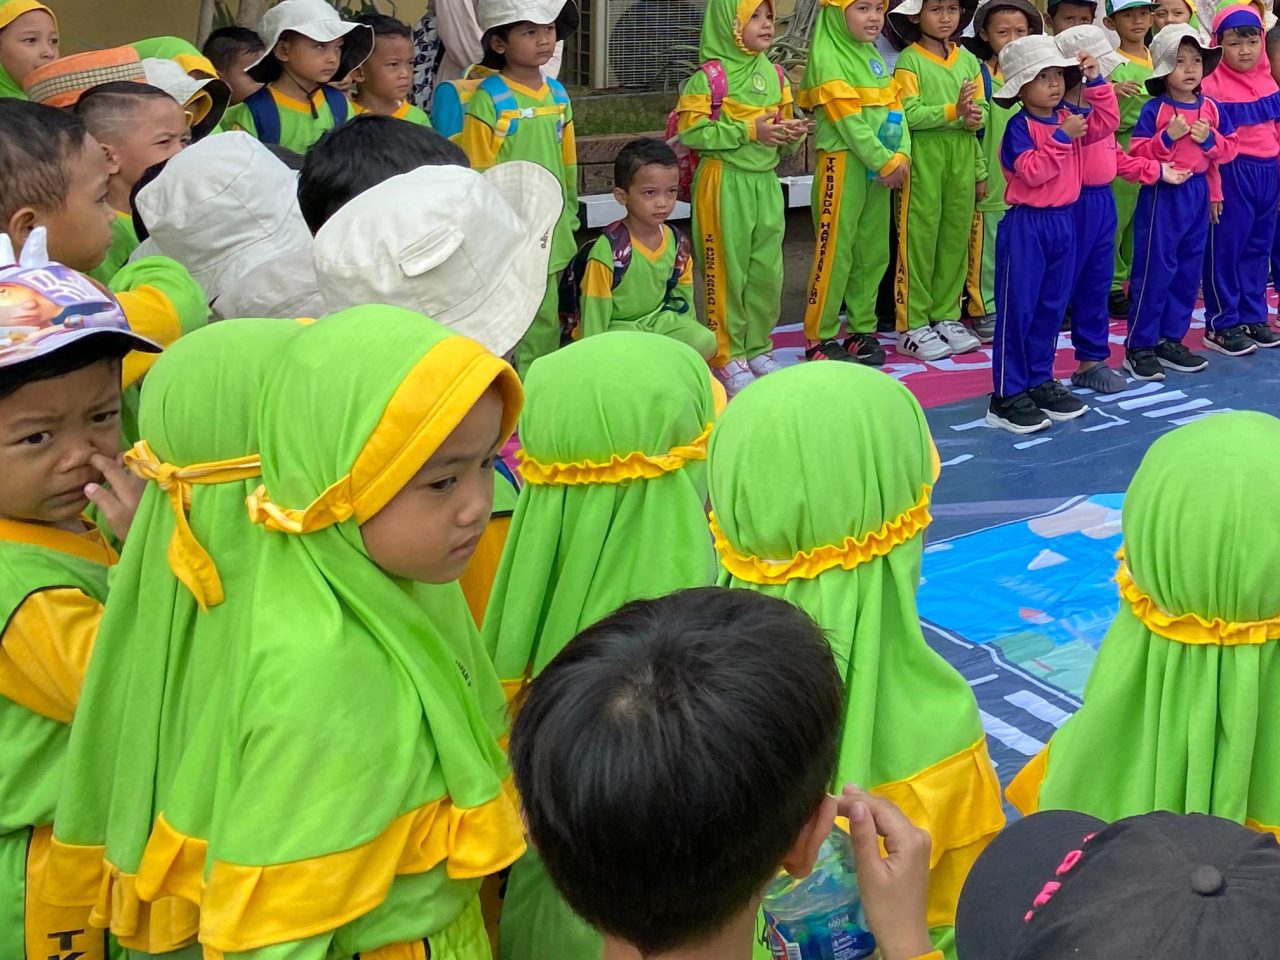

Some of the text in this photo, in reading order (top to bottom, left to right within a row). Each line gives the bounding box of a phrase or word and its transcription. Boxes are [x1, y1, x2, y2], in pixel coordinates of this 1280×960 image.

[826, 157, 837, 173] TK
[822, 175, 835, 215] BUNGA
[817, 222, 831, 273] HARAPAN
[814, 273, 821, 282] 2
